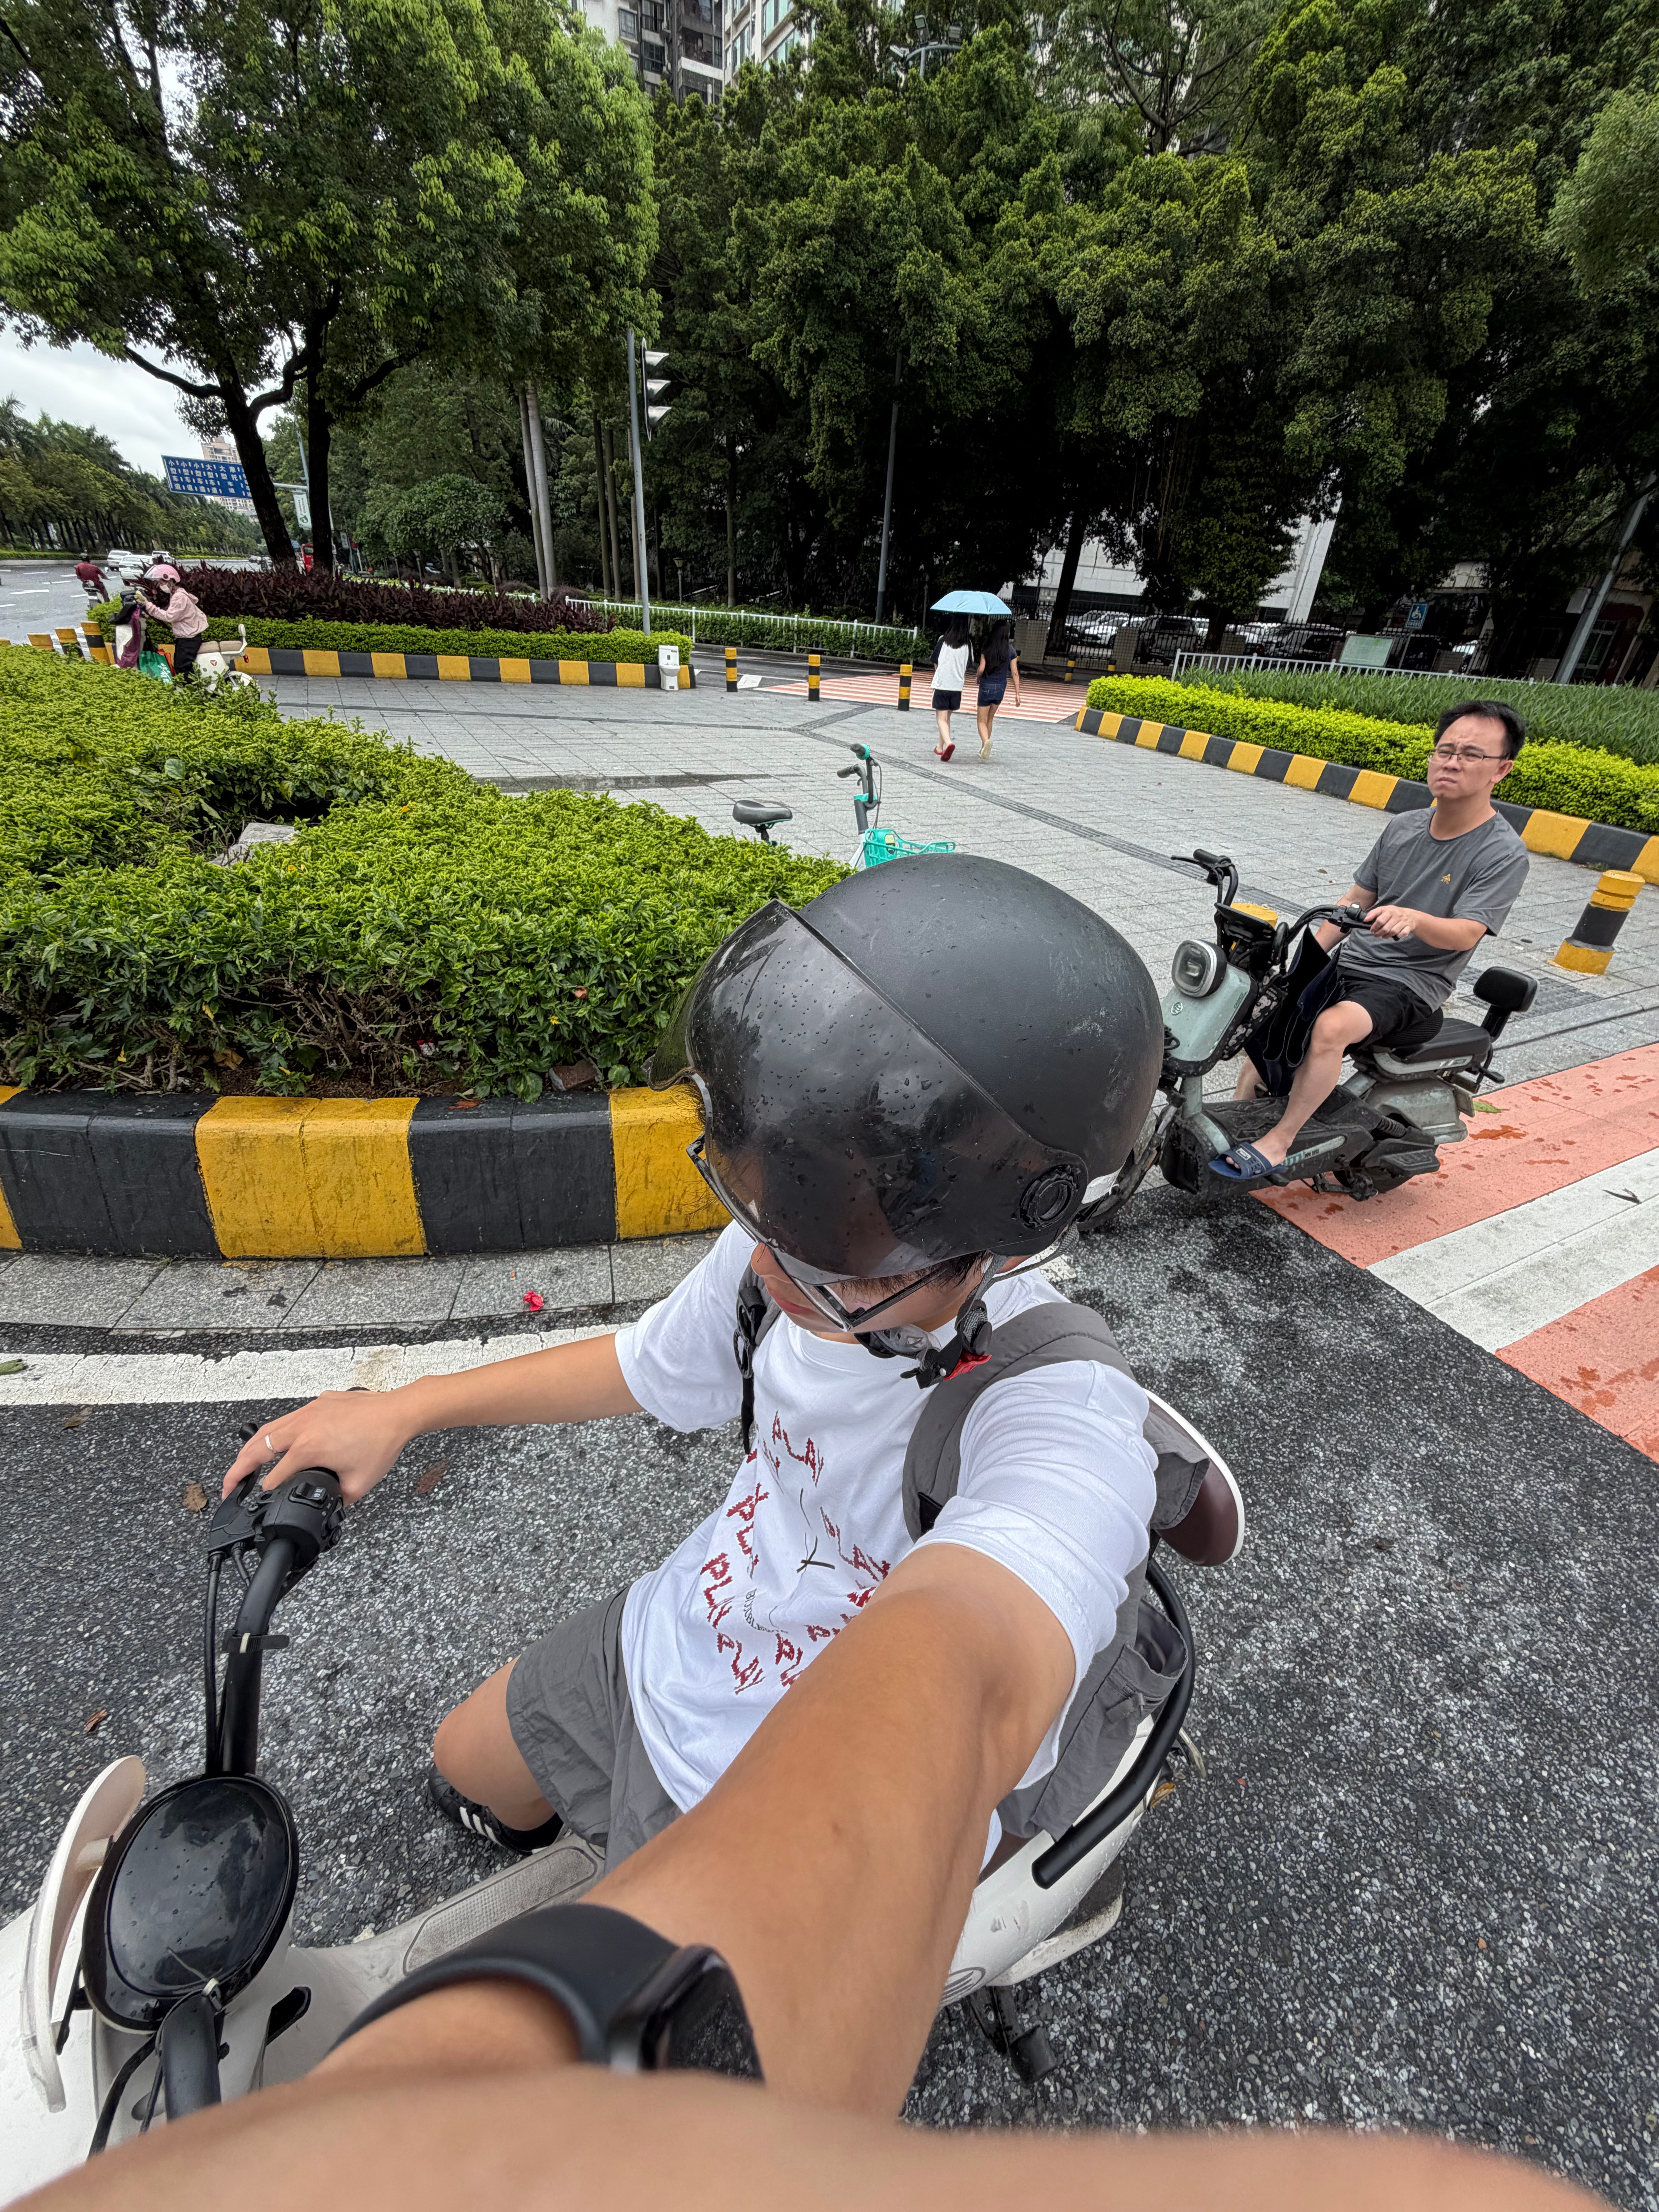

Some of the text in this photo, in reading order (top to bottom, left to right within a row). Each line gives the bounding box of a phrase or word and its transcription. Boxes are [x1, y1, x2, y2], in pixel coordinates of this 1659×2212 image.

[168, 460, 181, 490] 小型车道
[181, 461, 194, 491] 小型车道
[194, 462, 206, 493] 小型车道
[206, 464, 218, 494] 大型车道
